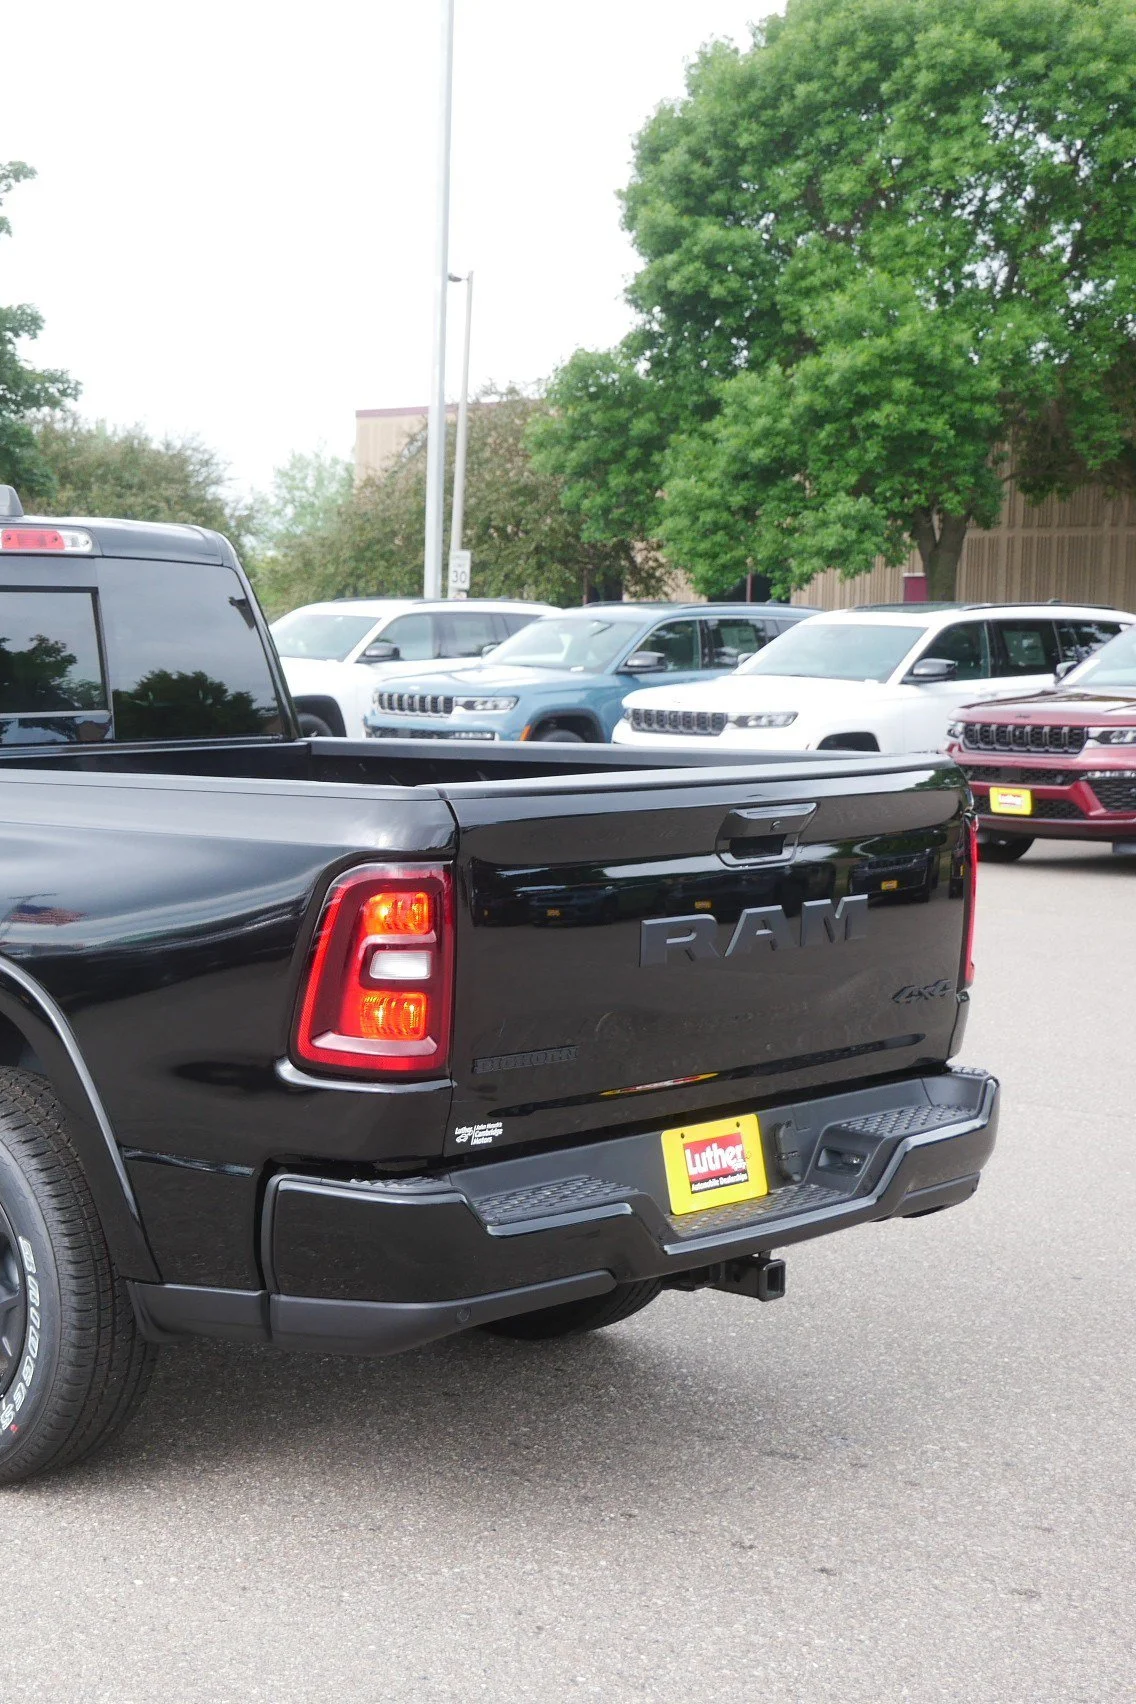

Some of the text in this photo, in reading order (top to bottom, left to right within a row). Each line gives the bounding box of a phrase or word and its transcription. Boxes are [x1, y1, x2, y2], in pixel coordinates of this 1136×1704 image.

[452, 570, 468, 584] 30
[639, 894, 869, 968] RAM
[684, 1142, 744, 1176] Luther
